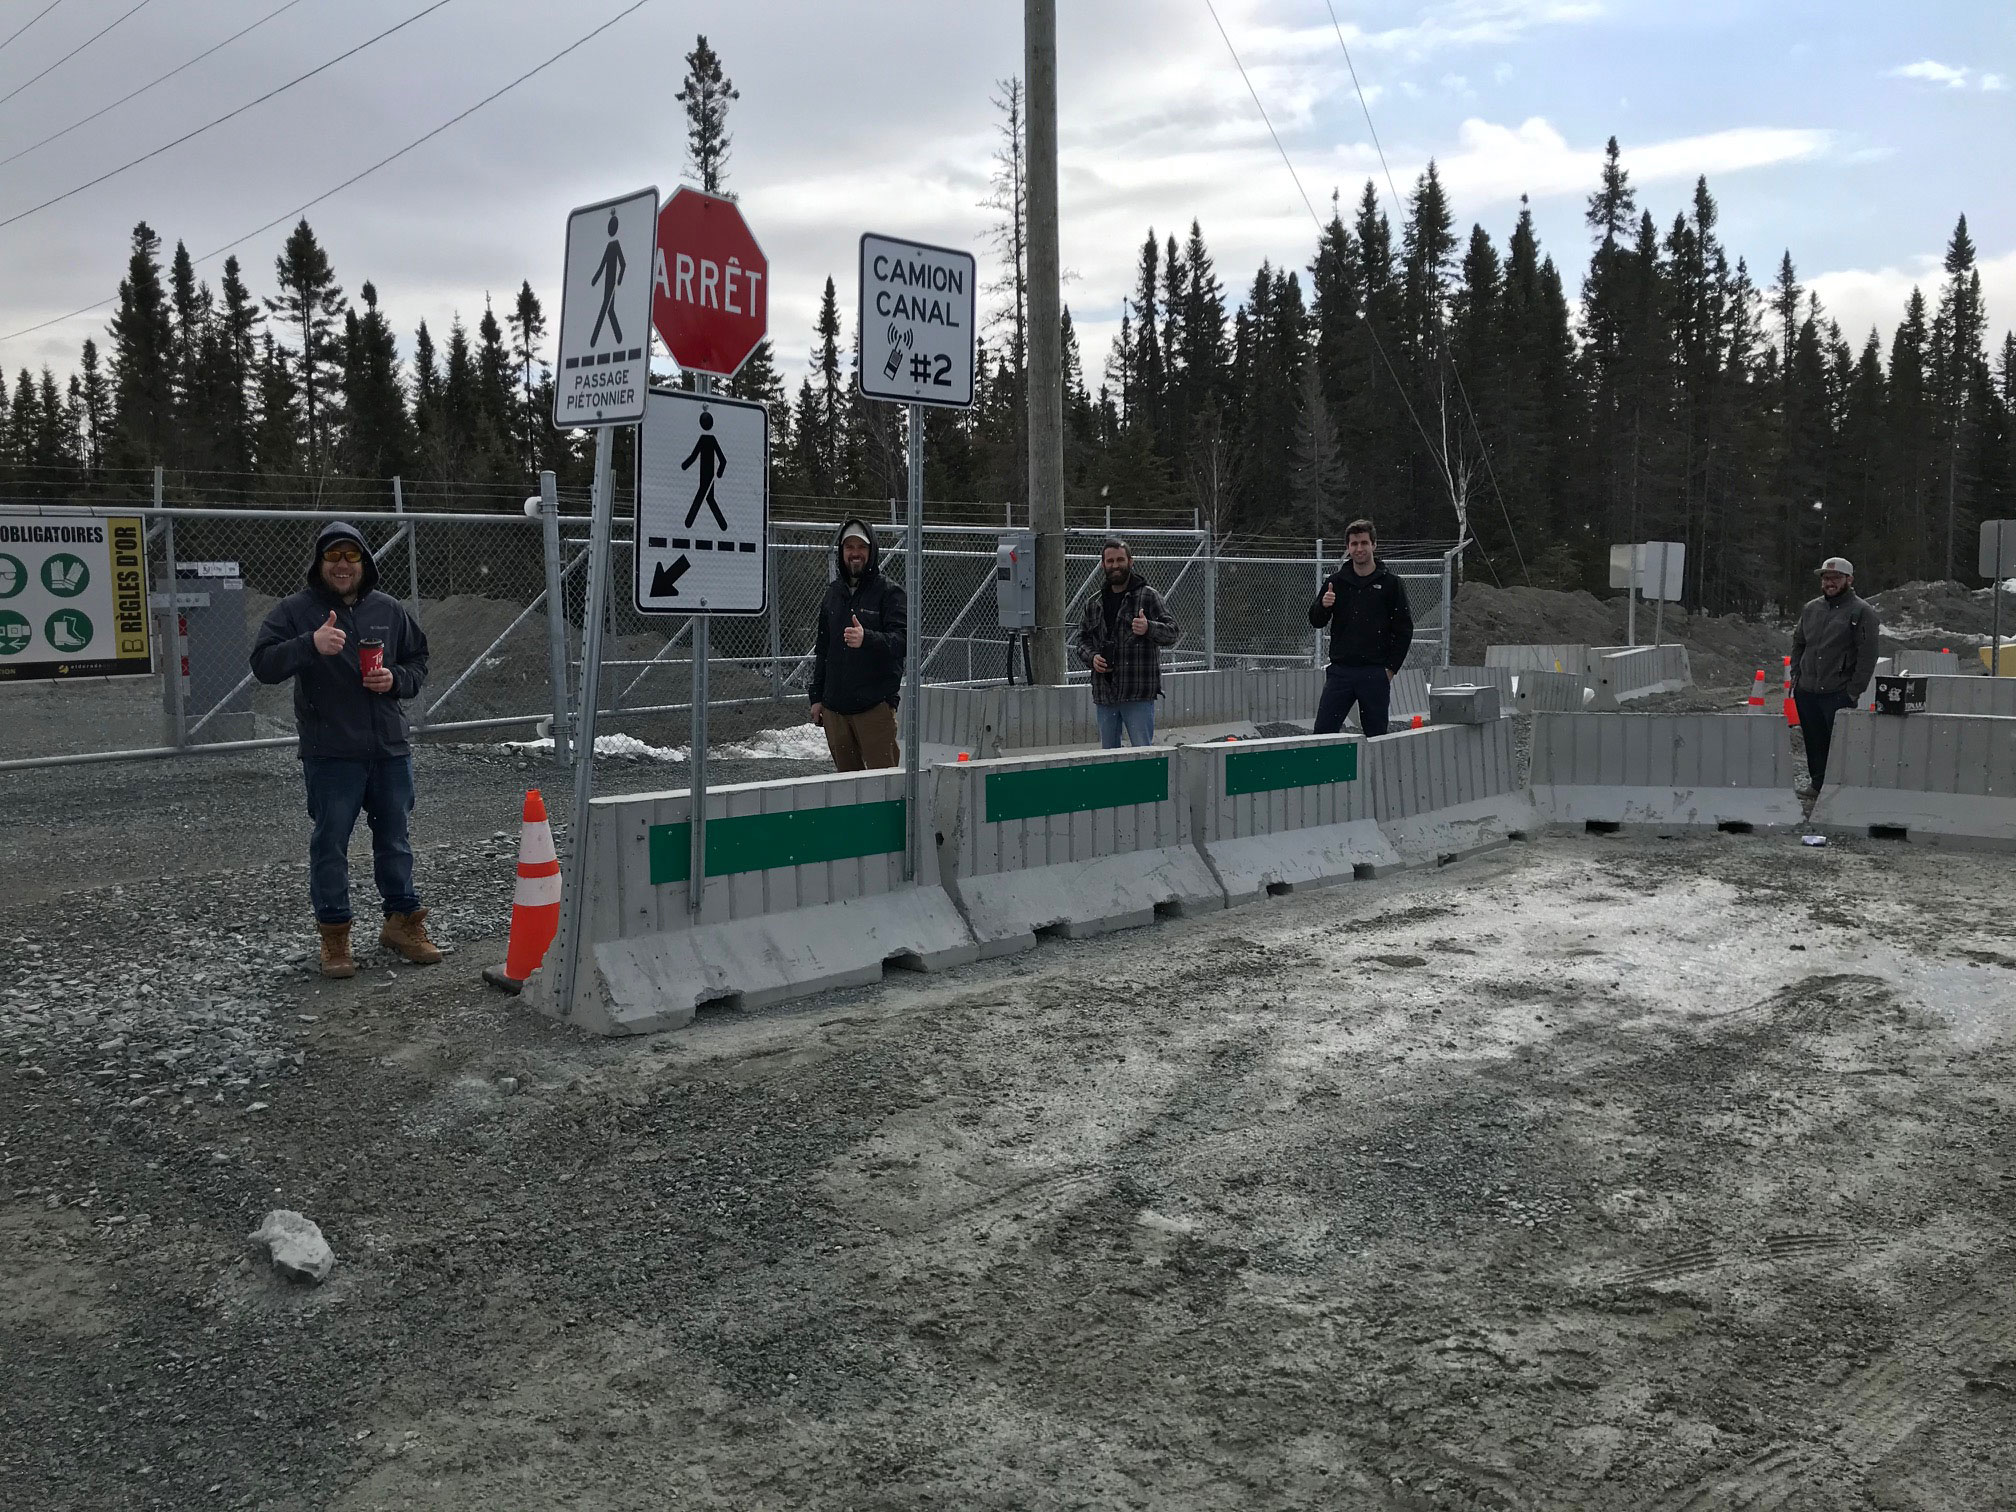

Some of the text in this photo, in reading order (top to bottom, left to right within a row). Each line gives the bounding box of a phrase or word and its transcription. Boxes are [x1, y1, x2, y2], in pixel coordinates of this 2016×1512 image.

[653, 247, 762, 318] ARRÊT
[873, 255, 963, 295] CAMION
[876, 290, 960, 328] CANAL
[574, 369, 630, 390] PASSAGE
[909, 353, 952, 387] #2
[566, 388, 635, 410] PIÉTONNIER
[0, 525, 104, 543] OBLIGATOIRES
[114, 526, 143, 633] RÈGLES D'OR
